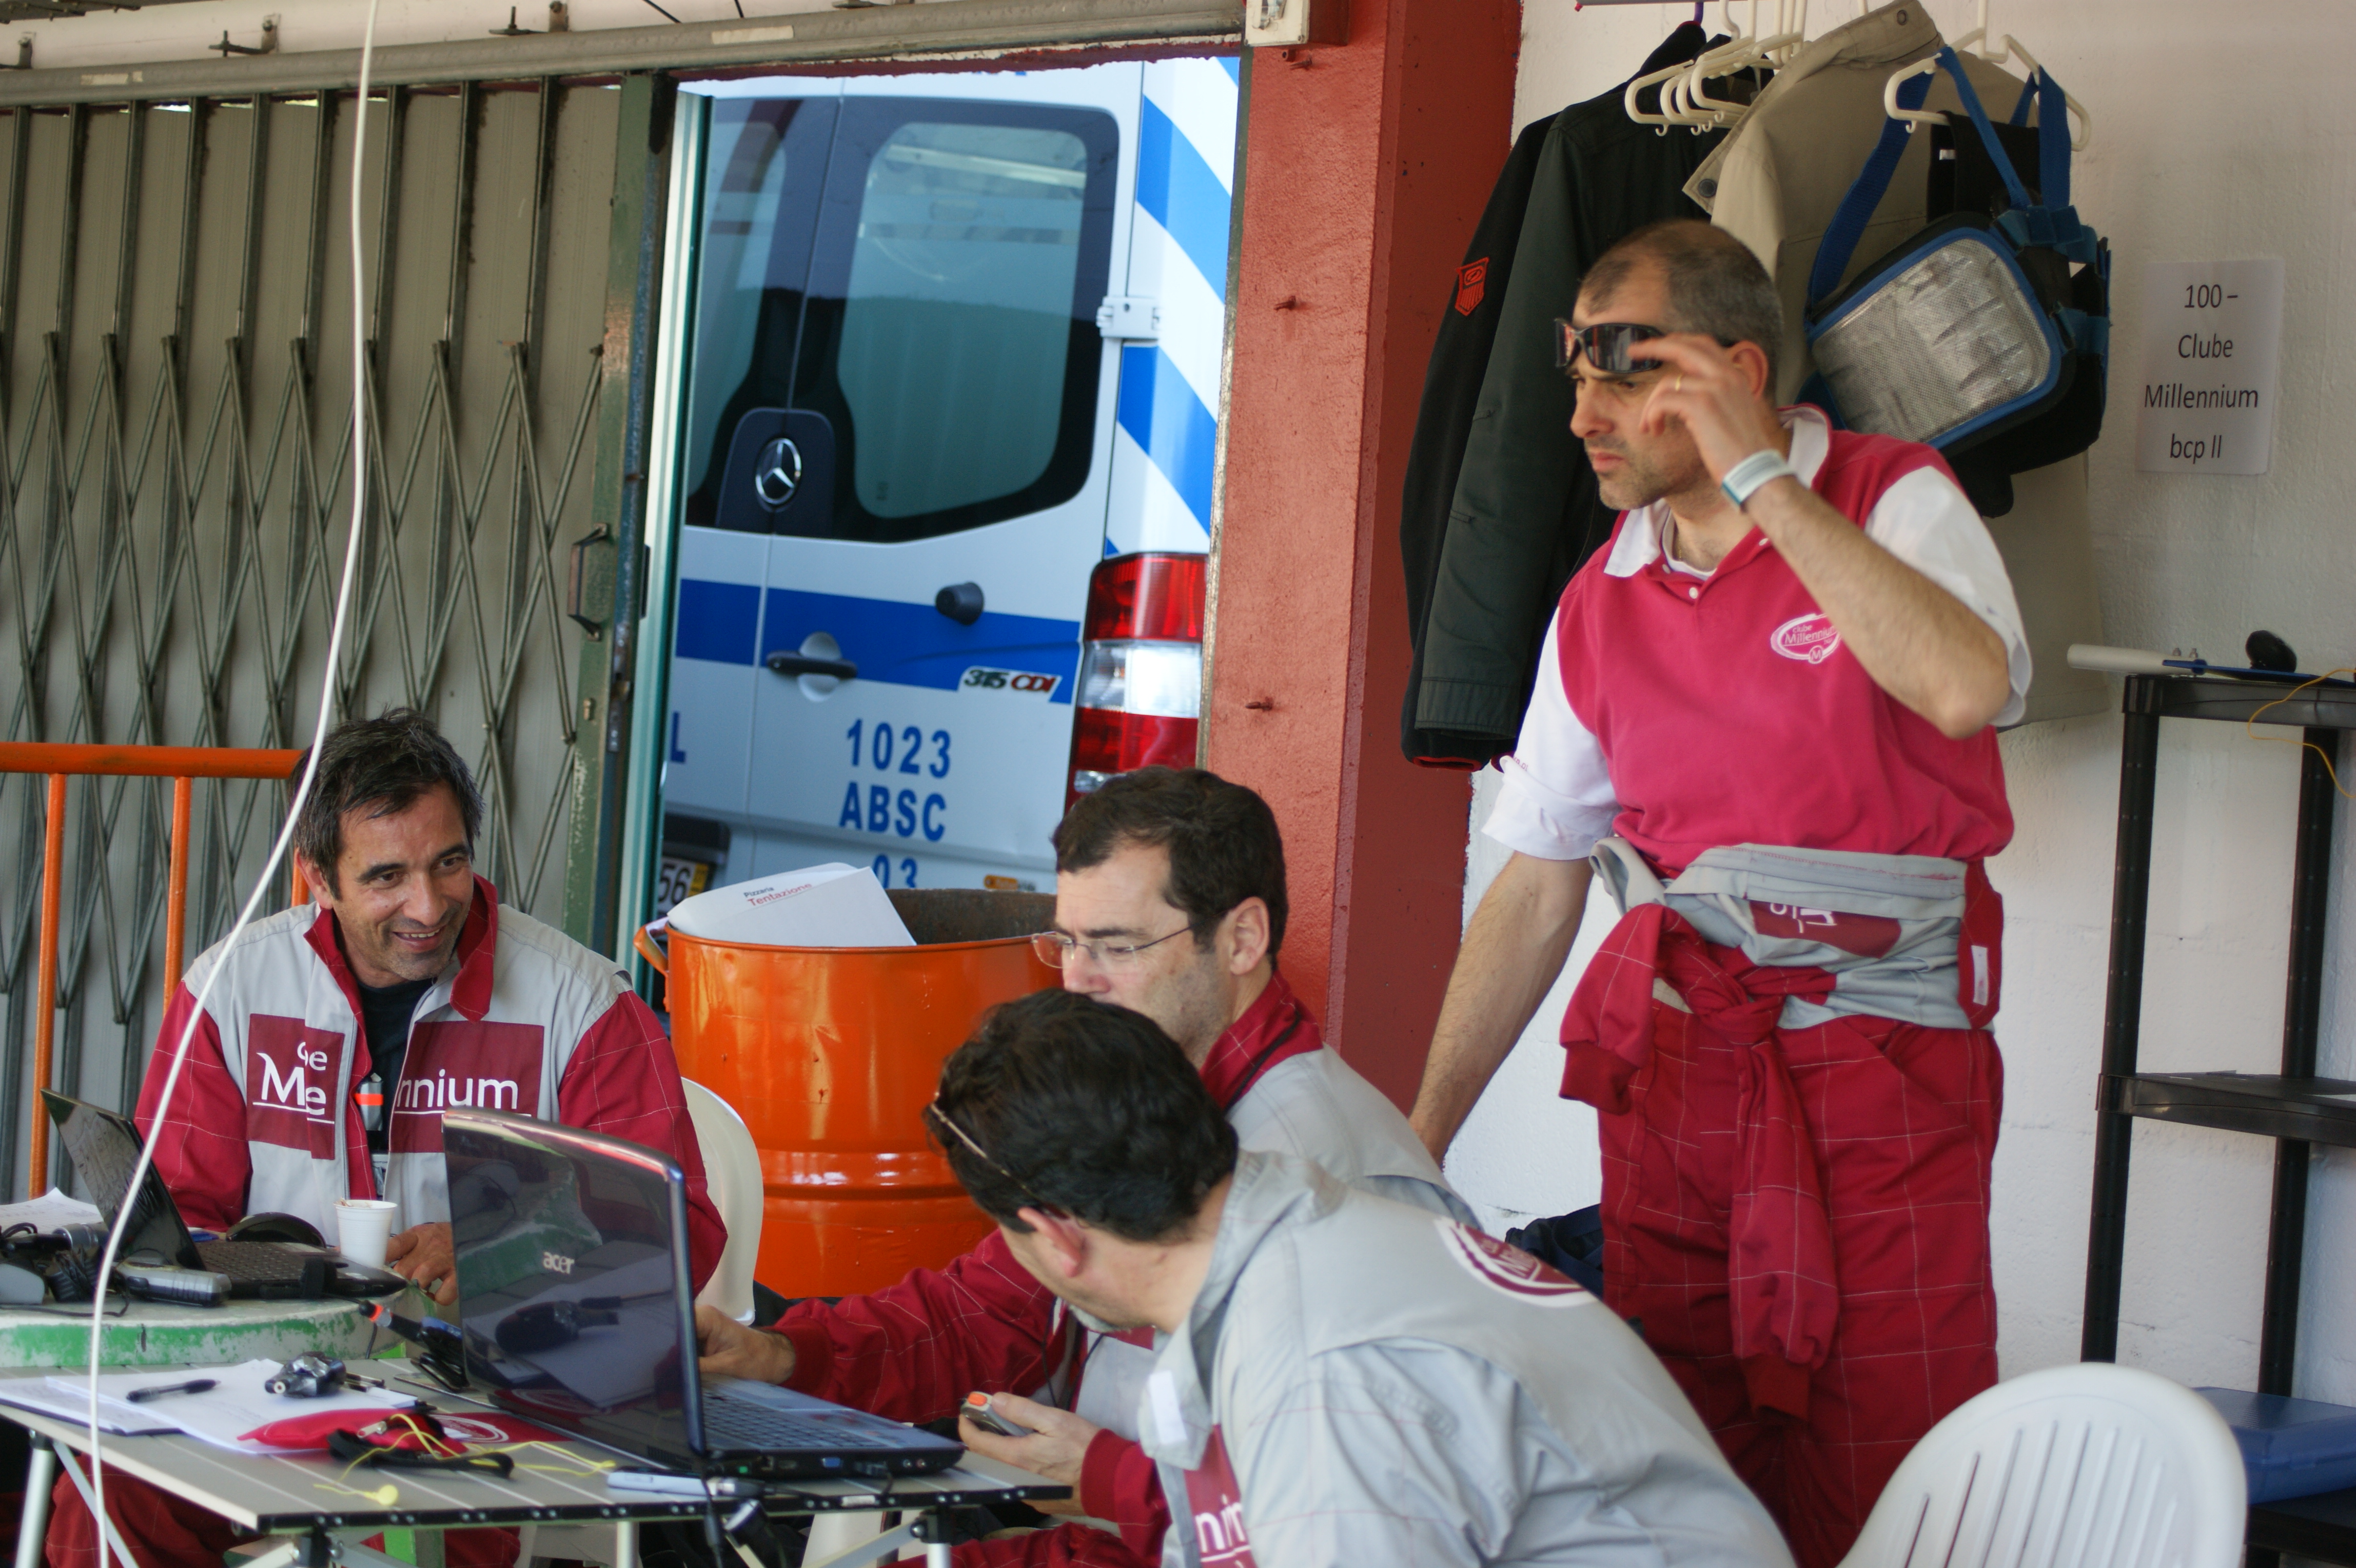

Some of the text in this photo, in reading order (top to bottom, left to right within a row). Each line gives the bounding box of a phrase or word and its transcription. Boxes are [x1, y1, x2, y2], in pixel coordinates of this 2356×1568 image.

[2184, 284, 2222, 308] 100
[2178, 333, 2233, 359] Clube
[2144, 383, 2259, 408] Millennium
[2170, 433, 2205, 465] bcp
[964, 669, 1057, 693] 315 CDI
[847, 718, 951, 779] 1023
[838, 781, 947, 842] ABSC
[743, 887, 774, 897] Pizzaria
[747, 883, 812, 906] Tentazione
[542, 1251, 575, 1274] acer
